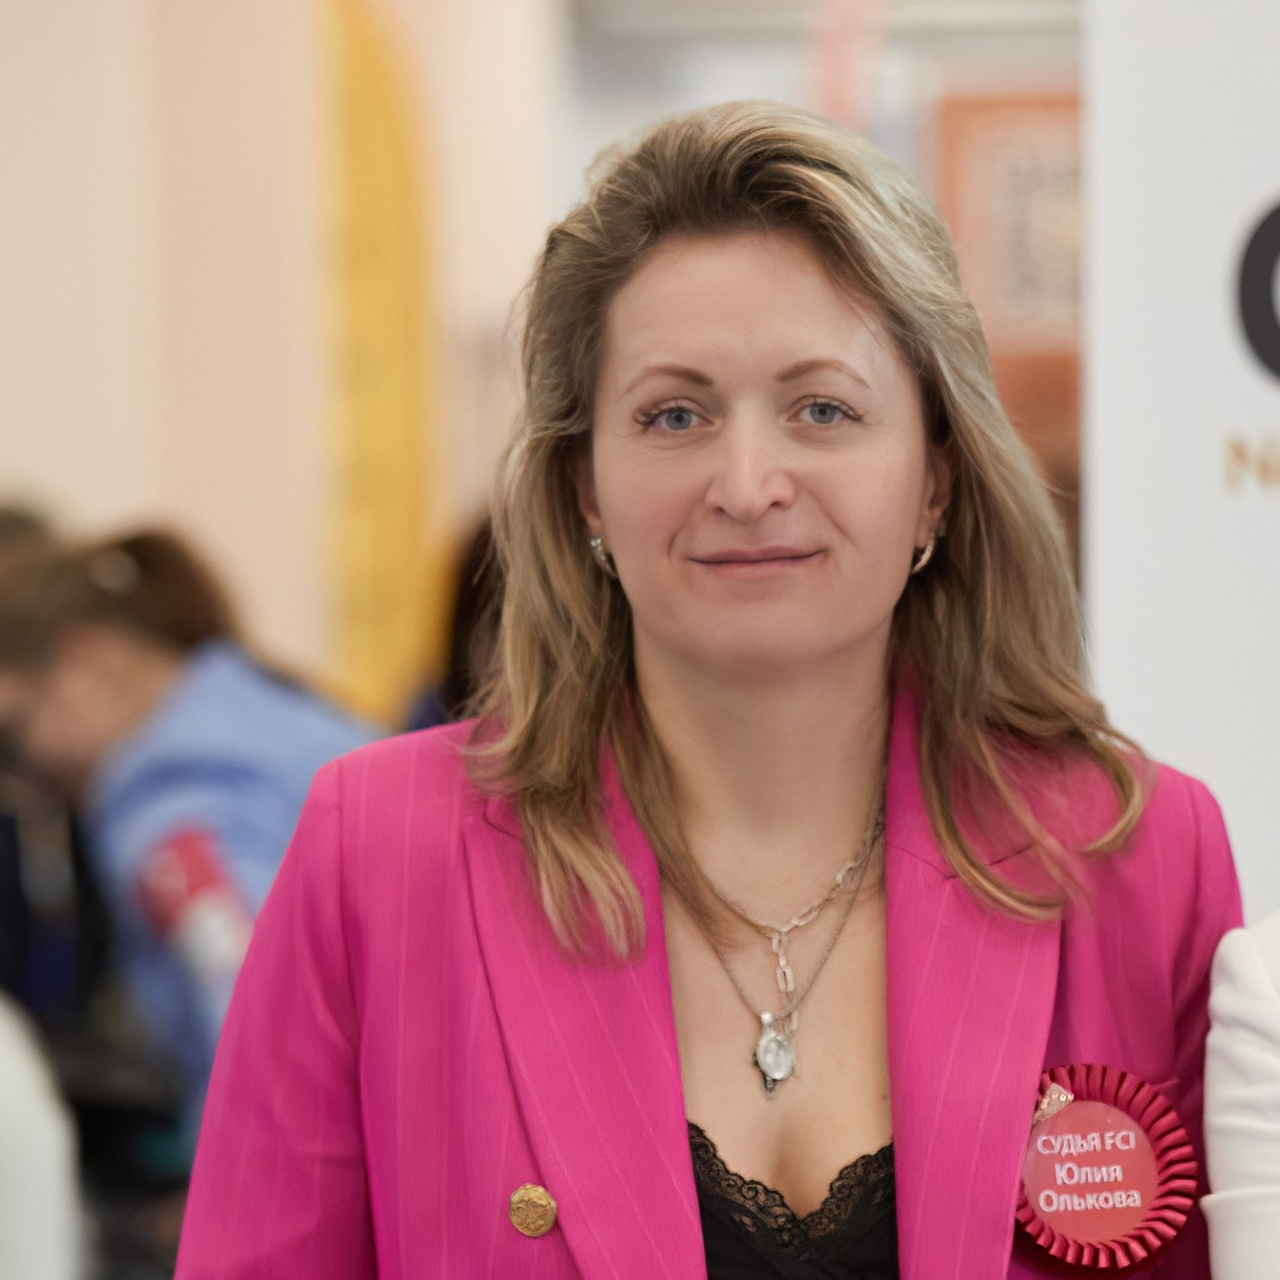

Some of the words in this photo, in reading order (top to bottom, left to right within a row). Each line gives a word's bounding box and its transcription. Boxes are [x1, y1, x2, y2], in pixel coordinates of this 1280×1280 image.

[1105, 1131, 1136, 1150] FCI
[1055, 1163, 1122, 1185] Юлия
[1039, 1190, 1141, 1213] Олькова
